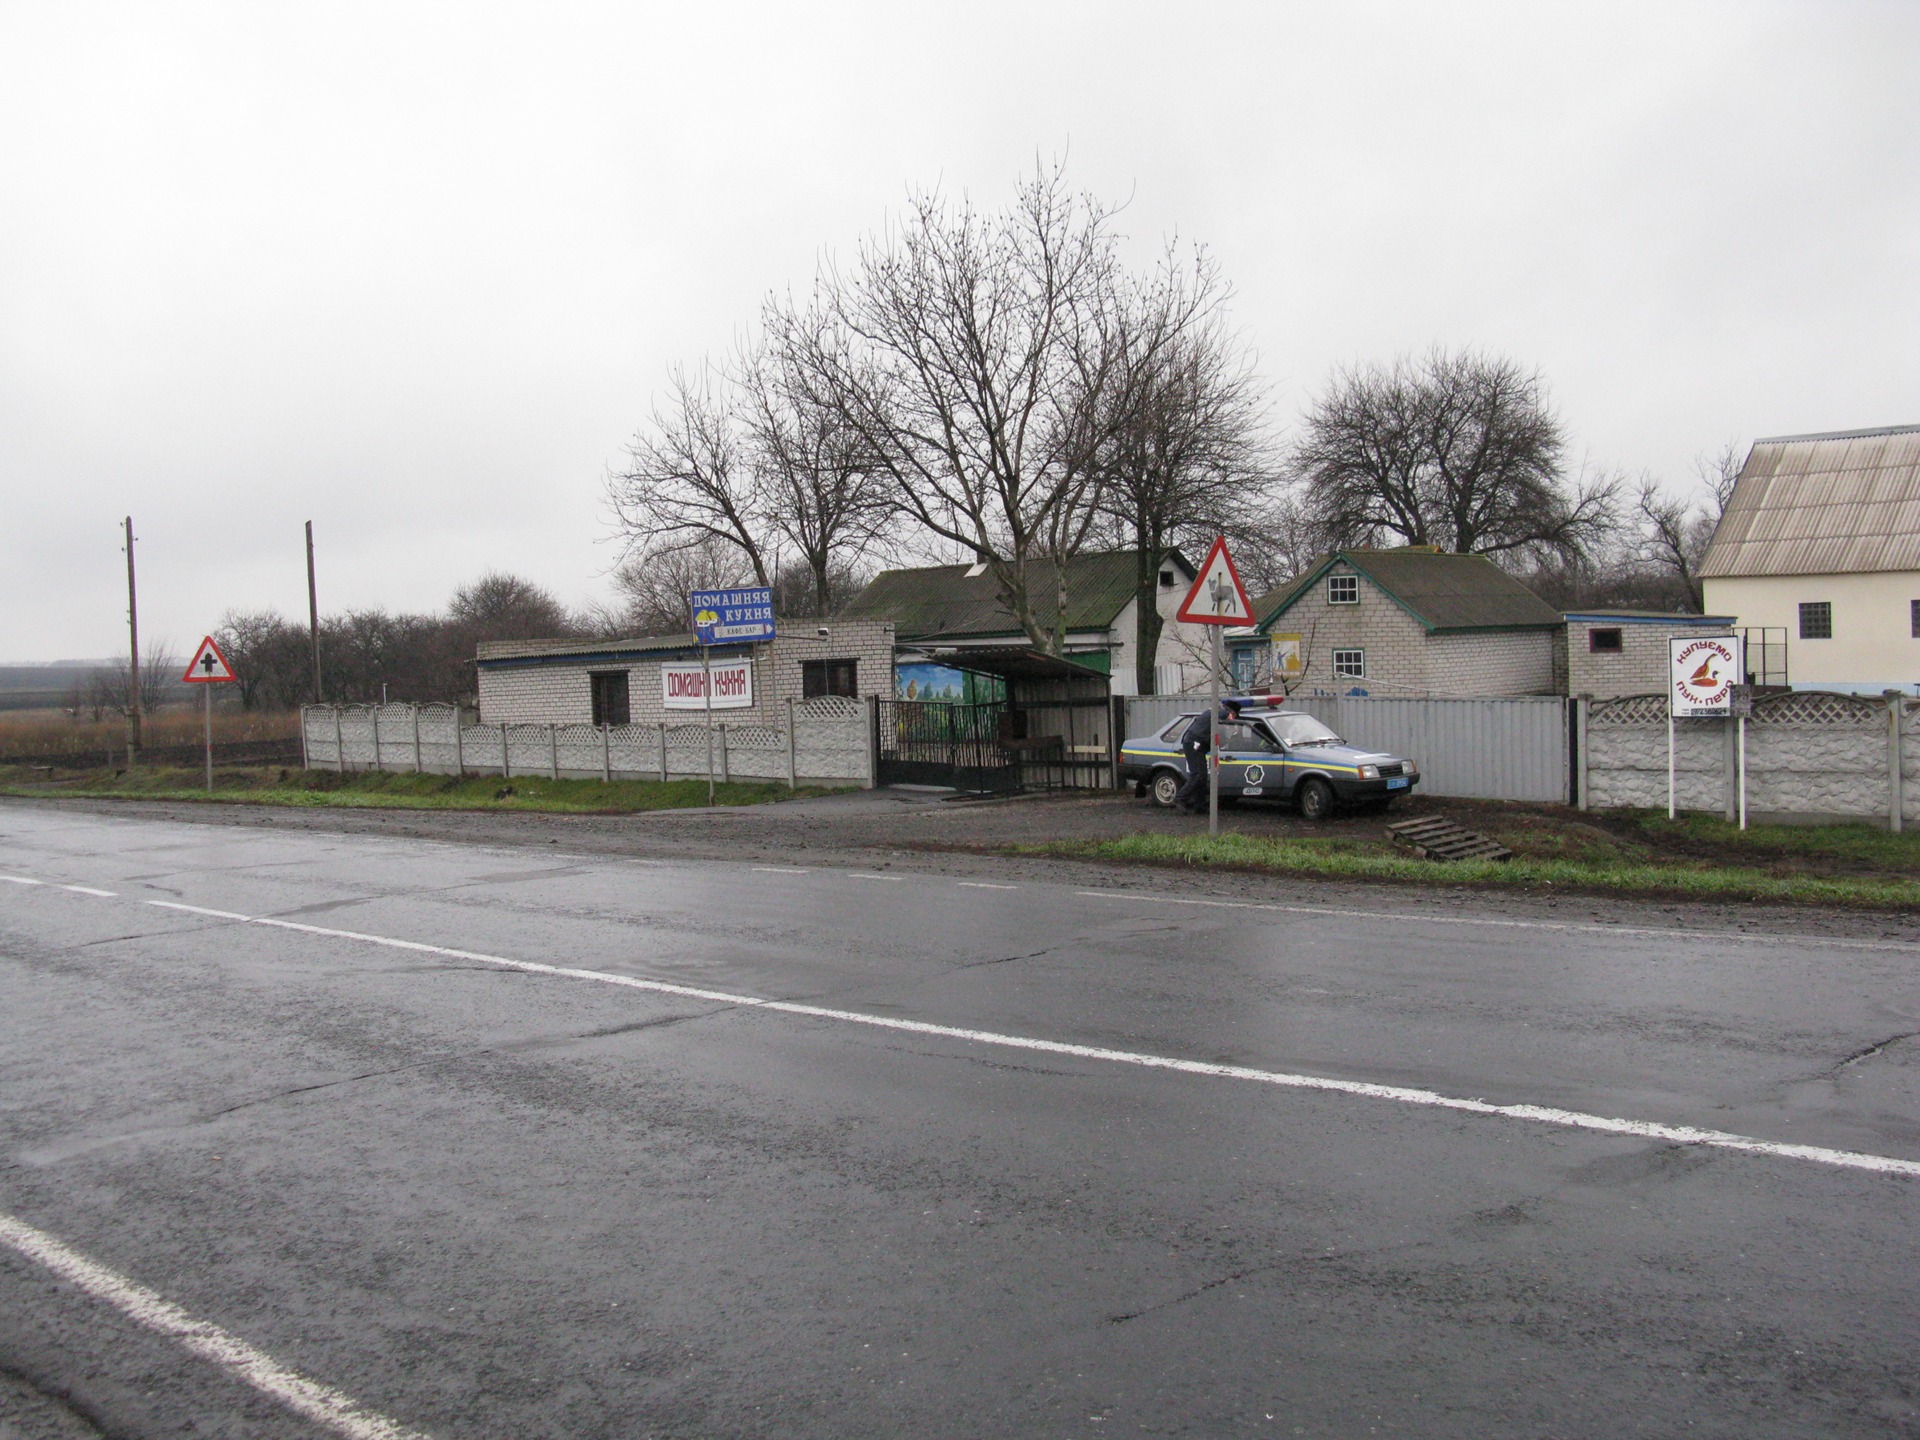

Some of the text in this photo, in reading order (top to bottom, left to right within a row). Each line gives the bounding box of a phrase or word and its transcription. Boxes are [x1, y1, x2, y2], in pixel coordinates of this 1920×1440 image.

[694, 592, 771, 607] ДОМАШНЯЯ
[726, 608, 772, 621] КУХНЯ
[1676, 641, 1732, 664] КУПУЄМО
[714, 669, 746, 696] КУХНЯ
[1676, 681, 1698, 704] ПУХ
